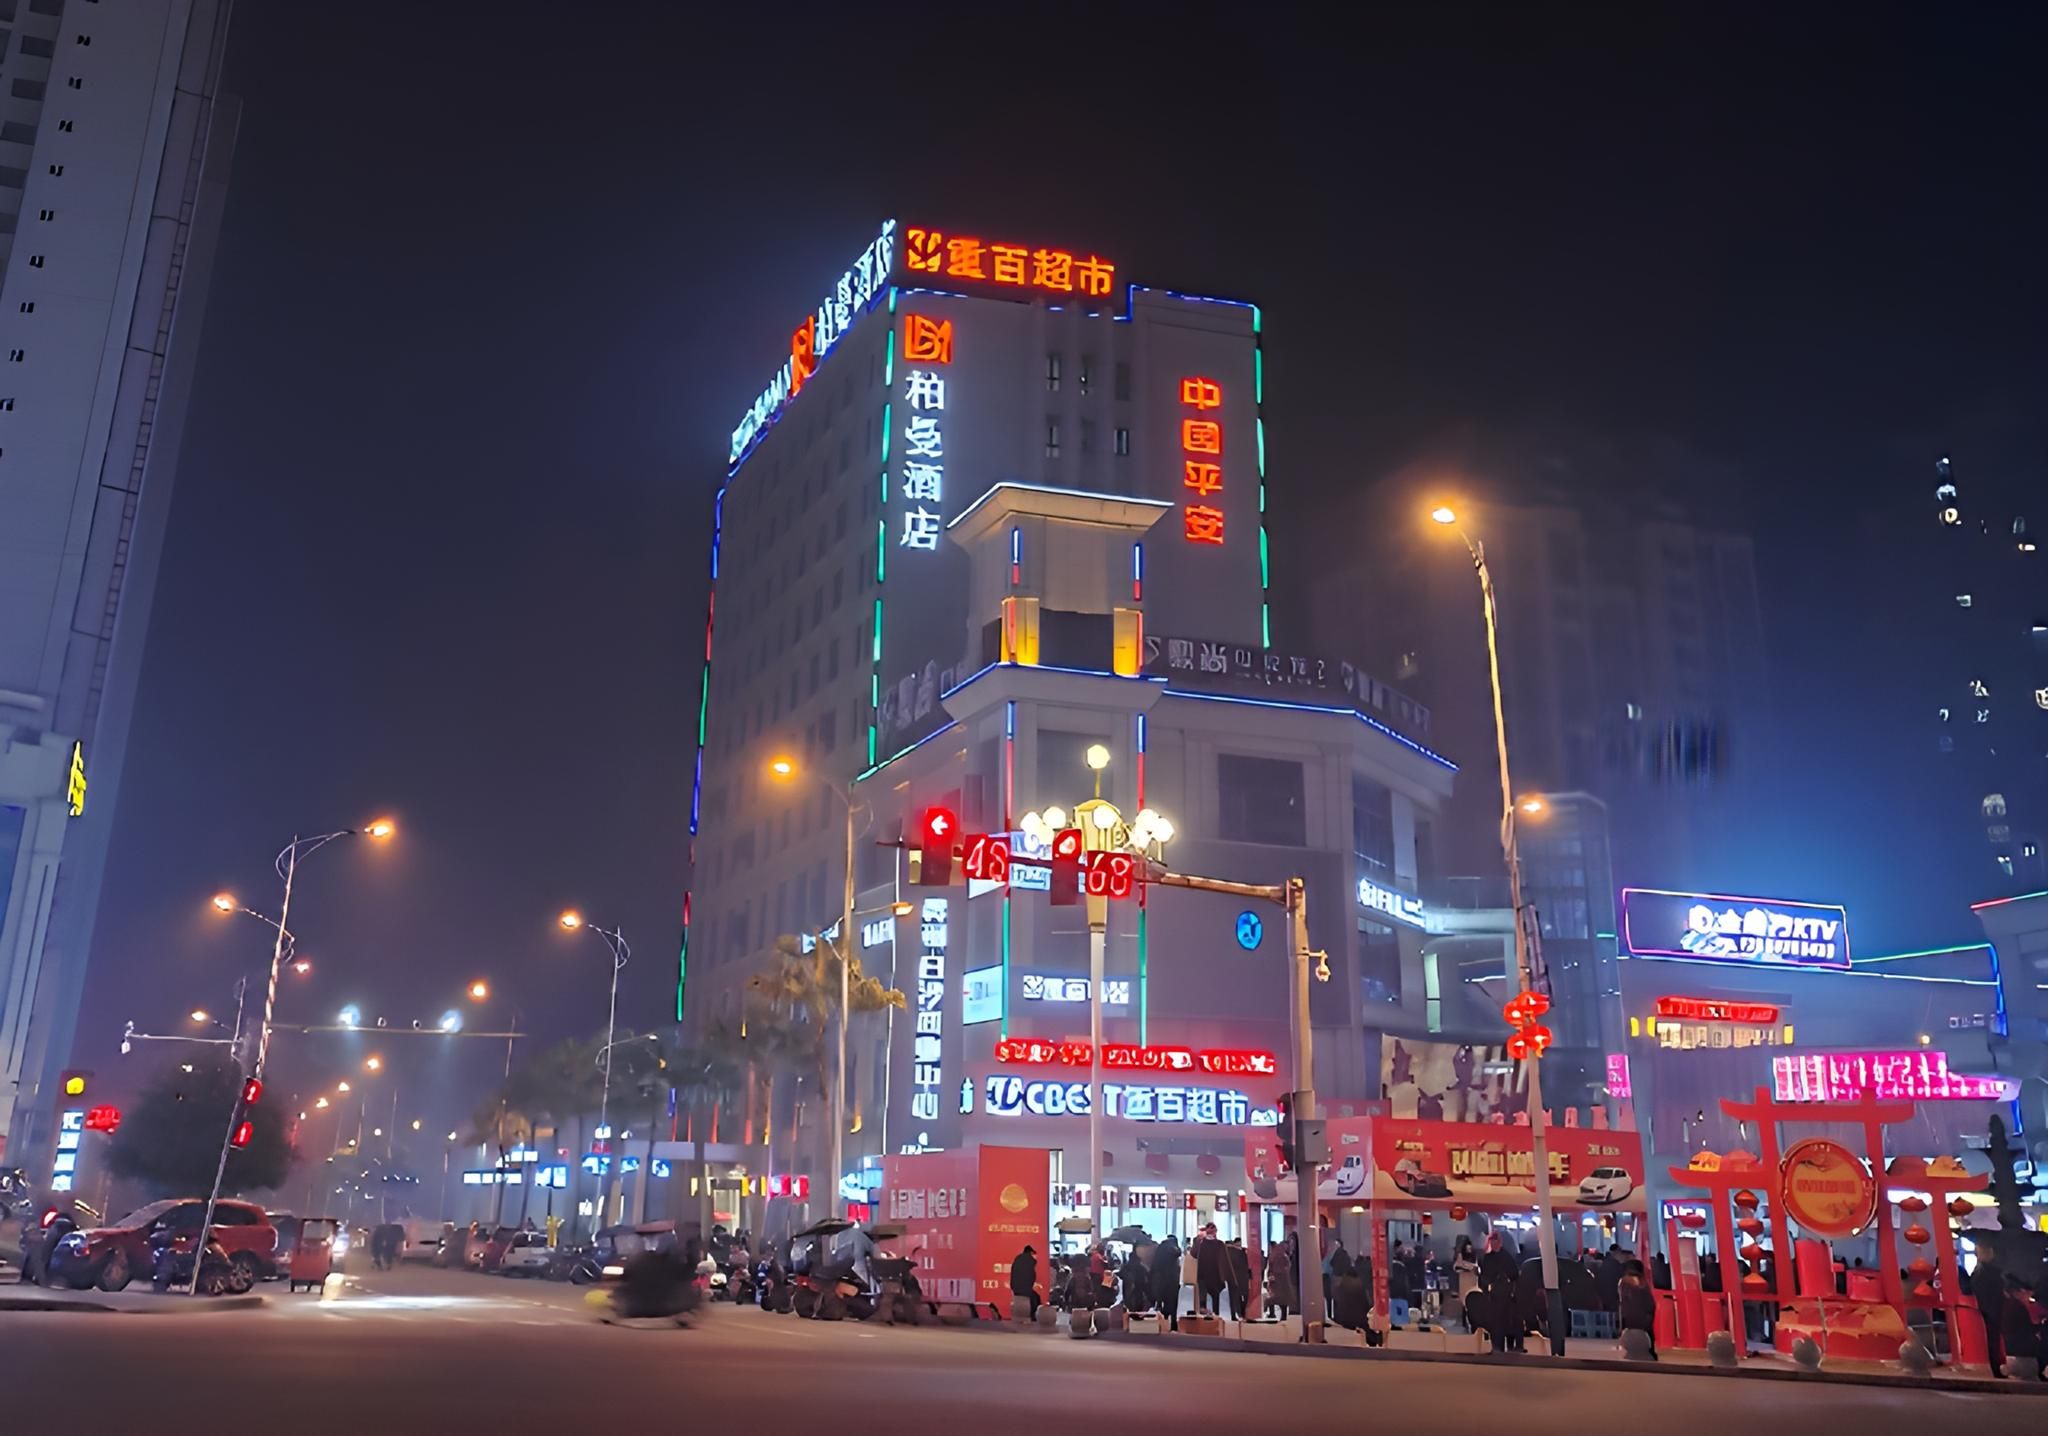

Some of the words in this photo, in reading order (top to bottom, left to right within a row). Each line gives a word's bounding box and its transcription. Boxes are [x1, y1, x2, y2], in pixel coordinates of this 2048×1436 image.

[947, 239, 1115, 295] 重百超市
[1183, 377, 1224, 545] 中国平安
